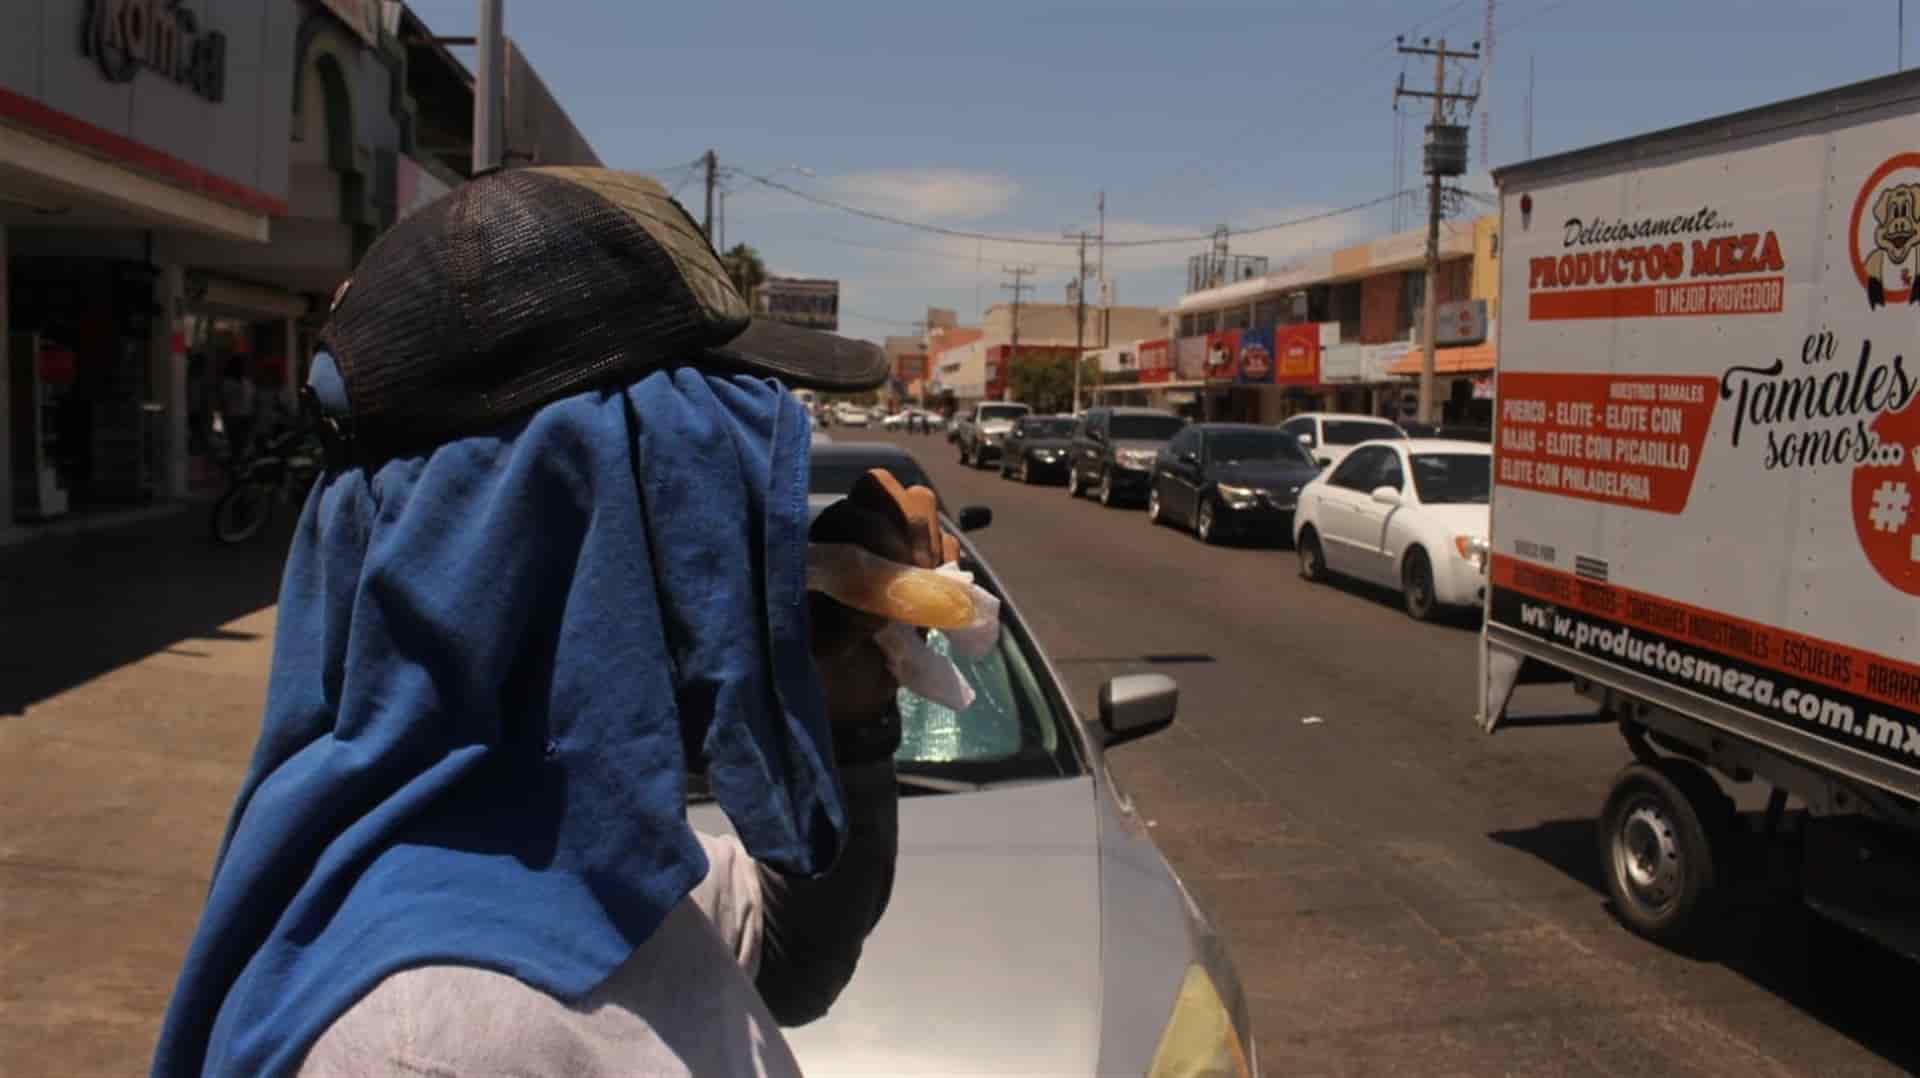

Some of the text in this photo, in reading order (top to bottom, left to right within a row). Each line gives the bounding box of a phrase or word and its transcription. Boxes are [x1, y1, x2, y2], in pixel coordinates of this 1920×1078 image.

[1529, 230, 1785, 289] PRODUCTOS MEZA
[1655, 279, 1781, 314] TU MEJOR PROVEEDOR
[1802, 331, 1838, 365] en
[1658, 384, 1705, 403] TAMALES
[1721, 339, 1918, 448] Tamales
[1503, 399, 1546, 423] PUERCO
[1556, 402, 1594, 427] ELOTE
[1605, 404, 1648, 432] ELOTE
[1651, 407, 1682, 434] CON
[1546, 431, 1583, 459] ELOTE
[1585, 435, 1613, 461] CON
[1615, 438, 1690, 471] PICADILLO
[1764, 419, 1901, 470] somos...
[1501, 458, 1651, 502] ELOTE CON PHILADELPHIA
[1783, 638, 1851, 682] ESCUELAS
